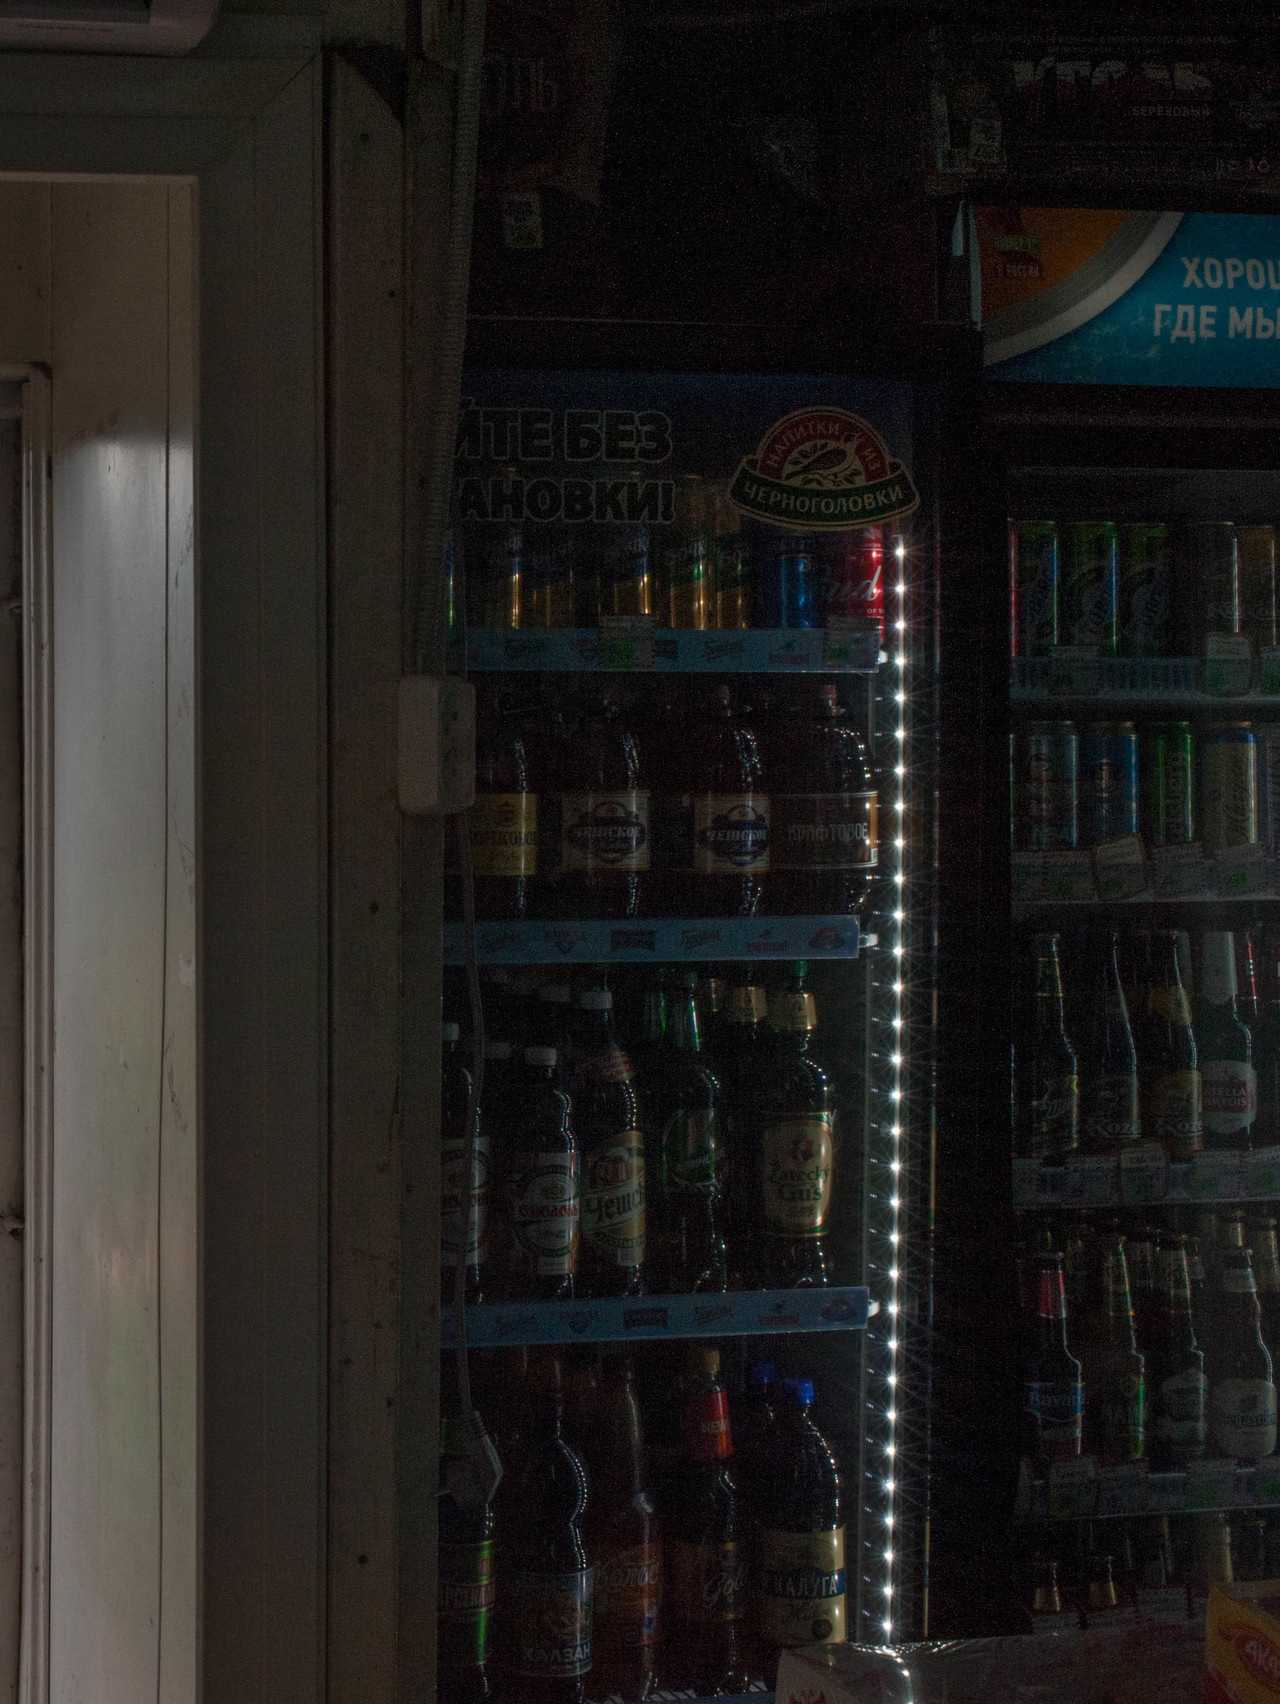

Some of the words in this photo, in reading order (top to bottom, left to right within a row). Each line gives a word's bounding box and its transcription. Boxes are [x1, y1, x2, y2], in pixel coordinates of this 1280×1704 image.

[1154, 304, 1218, 344] ГДЕ
[564, 408, 673, 464] БЕЗ
[743, 480, 904, 515] ЧЕРНОГОЛОВКИ
